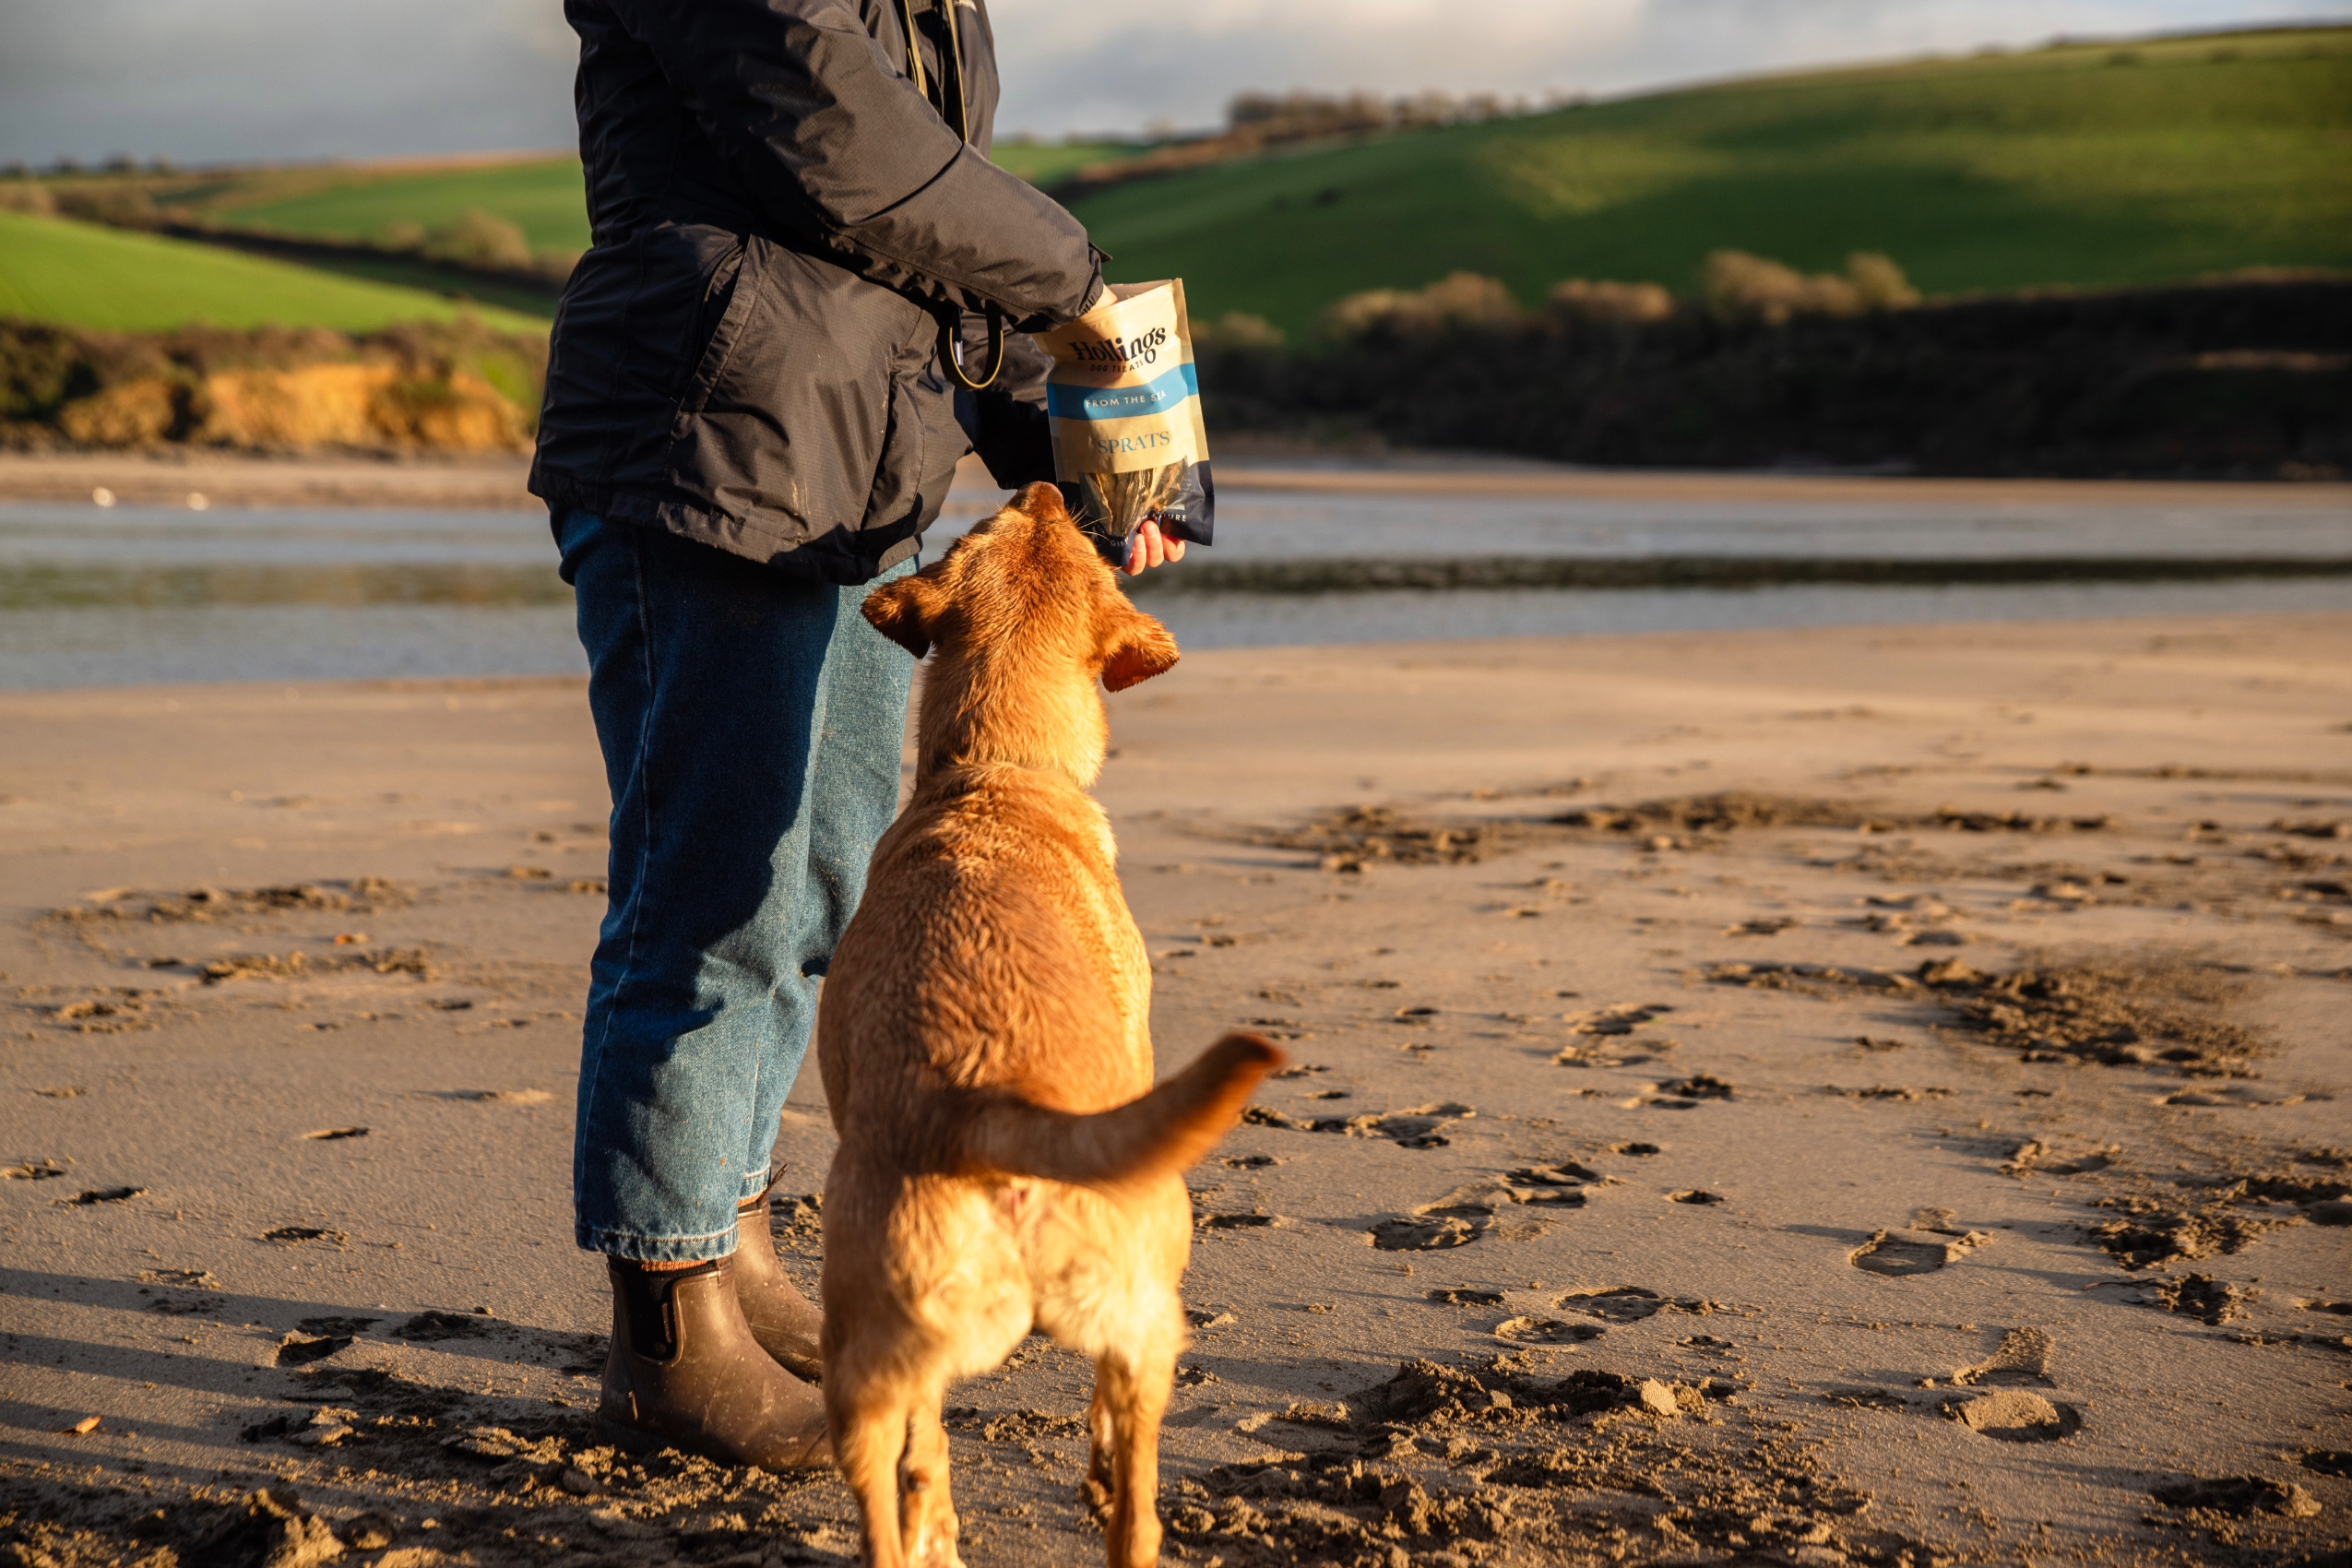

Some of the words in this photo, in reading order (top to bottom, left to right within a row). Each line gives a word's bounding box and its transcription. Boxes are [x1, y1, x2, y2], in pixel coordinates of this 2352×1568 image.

[1068, 327, 1166, 364] Hollings
[1089, 363, 1108, 372] DOG
[1111, 359, 1144, 373] TREATS
[1086, 398, 1120, 408] FROM
[1123, 395, 1146, 405] THE
[1150, 389, 1167, 402] SEA
[1097, 431, 1170, 455] SPRATS
